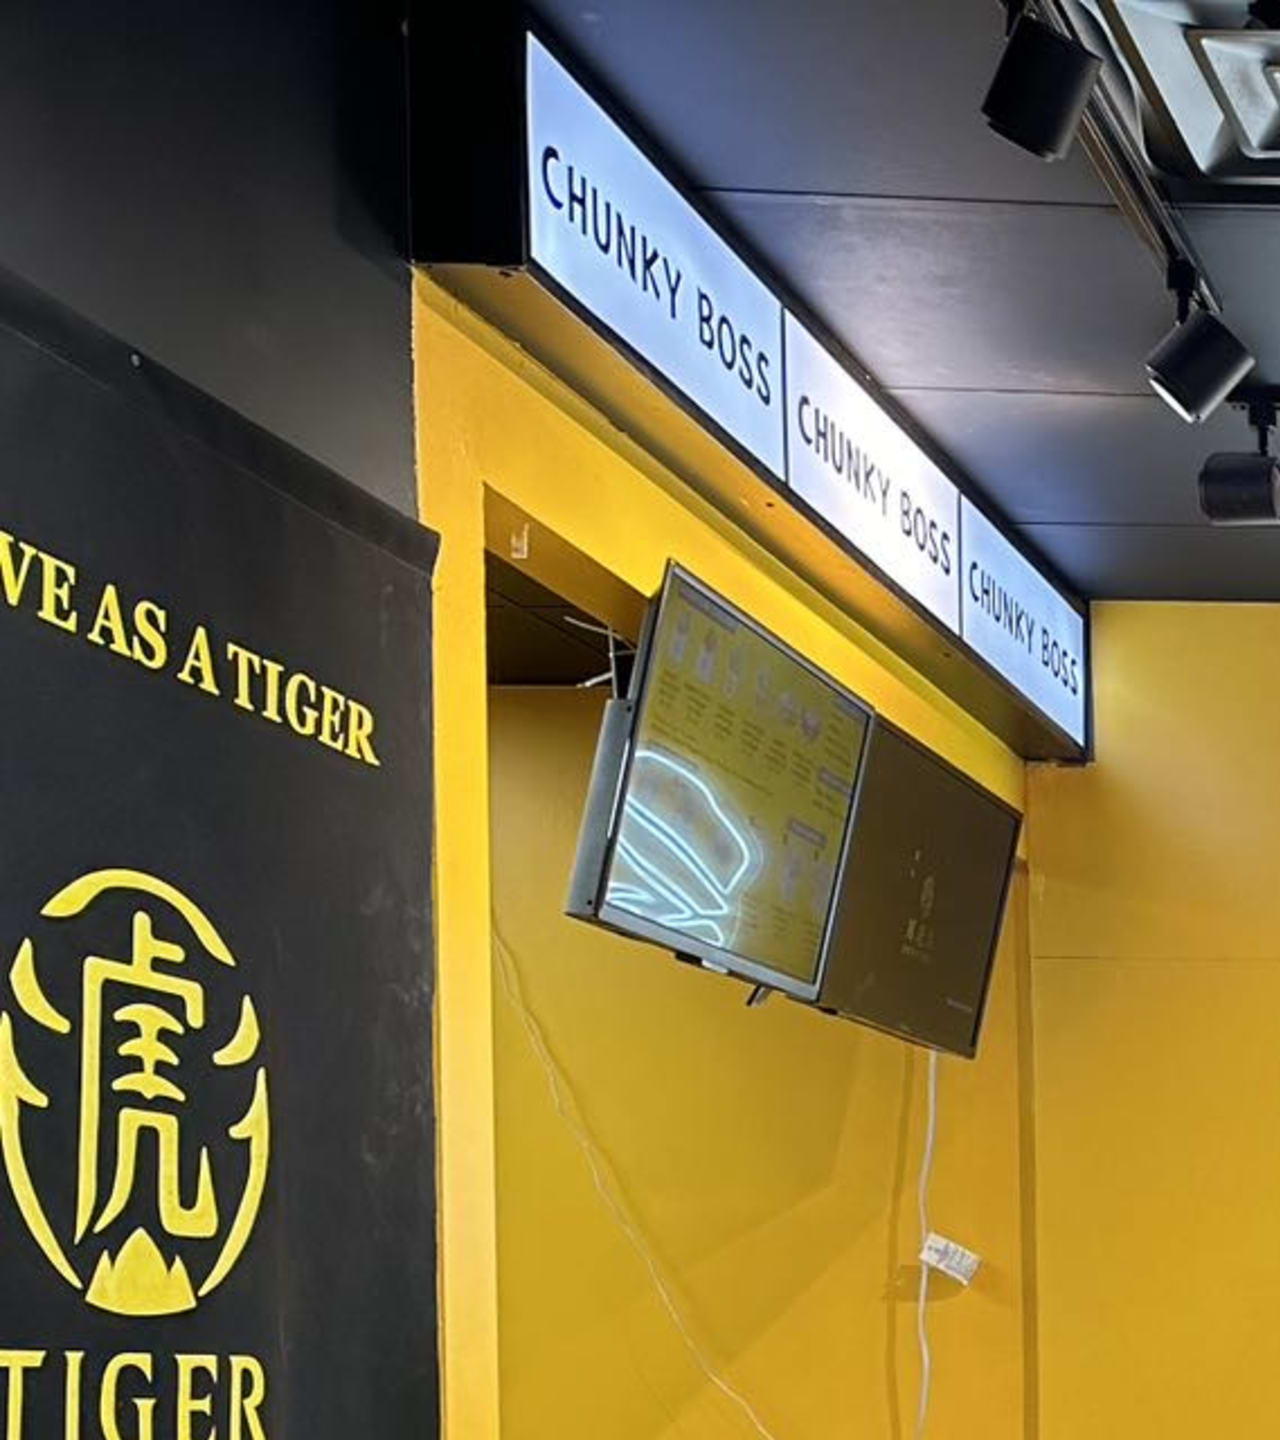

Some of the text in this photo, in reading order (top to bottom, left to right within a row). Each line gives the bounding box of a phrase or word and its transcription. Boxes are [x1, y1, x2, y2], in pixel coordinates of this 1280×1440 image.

[542, 147, 771, 406] CHUNKY BOSS
[797, 395, 951, 576] CHUNKY BOSS
[87, 583, 168, 669] AS
[178, 625, 220, 696] A
[226, 642, 381, 766] TIGER
[970, 560, 1079, 696] CHUNKY BOSS
